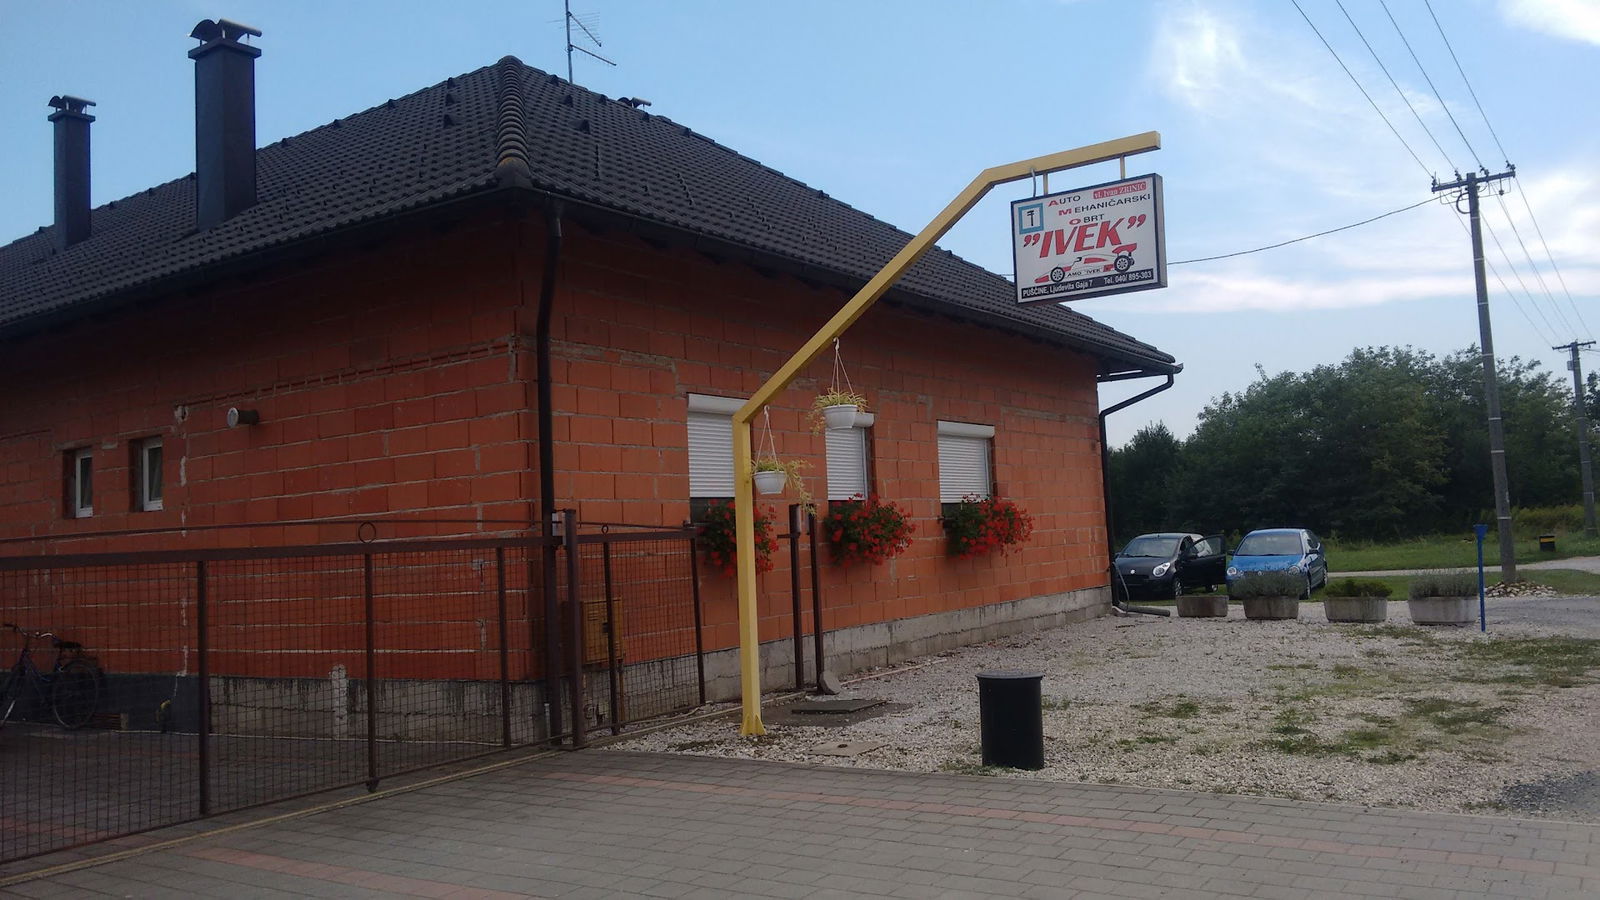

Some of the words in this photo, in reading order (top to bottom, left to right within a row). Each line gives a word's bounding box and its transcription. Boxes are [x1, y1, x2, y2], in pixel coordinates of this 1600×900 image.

[1048, 195, 1081, 207] AUTO
[1058, 193, 1151, 216] MEHANIČARSKI
[1069, 213, 1105, 225] OBRT
[1075, 281, 1088, 291] Gaja
[1104, 277, 1114, 285] Tel.
